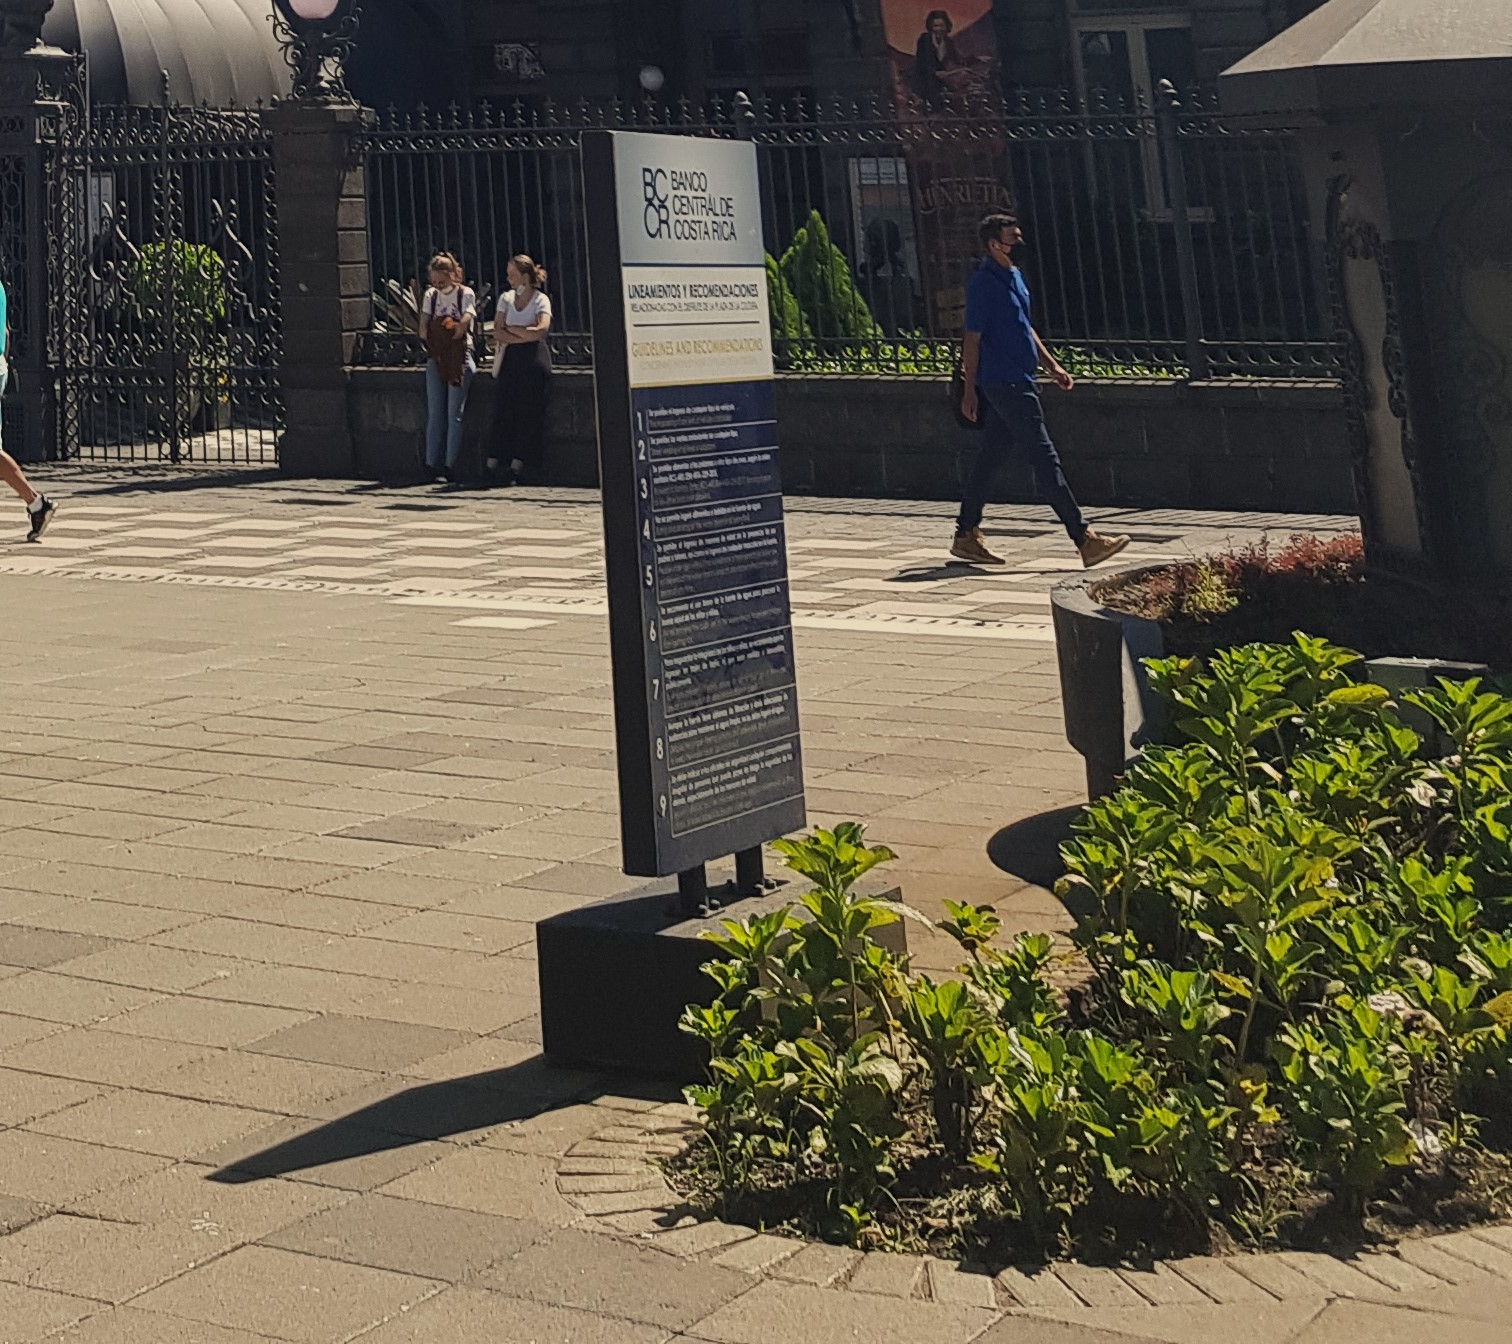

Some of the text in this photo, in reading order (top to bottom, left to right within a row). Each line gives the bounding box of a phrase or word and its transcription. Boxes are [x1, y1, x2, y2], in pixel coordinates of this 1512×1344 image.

[671, 170, 708, 192] BANCO
[672, 194, 735, 218] CENTRAL DE
[674, 219, 738, 241] COSTA RICA
[628, 283, 759, 300] LINEAMIENTOS Y RECOMENDACIONES
[636, 412, 643, 432] 1
[637, 439, 646, 461] 2
[640, 478, 648, 500] 3
[642, 518, 651, 540] 4
[644, 564, 653, 587] 5
[648, 619, 656, 642] 6
[652, 678, 659, 701] 7
[655, 737, 664, 760] 8
[659, 794, 667, 818] 9
